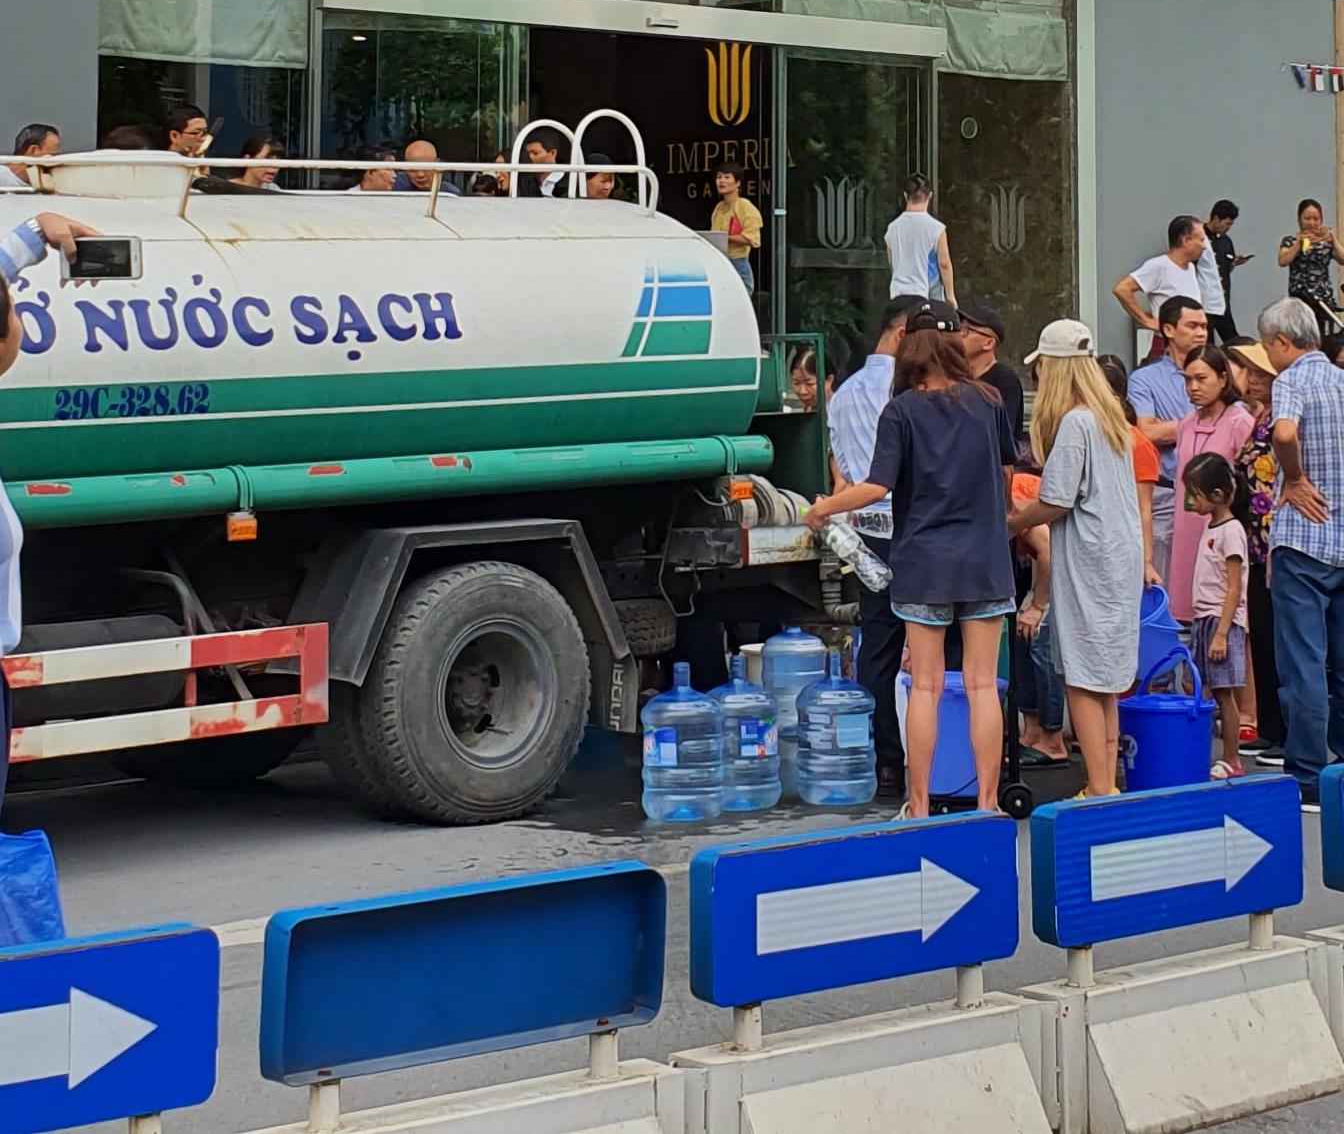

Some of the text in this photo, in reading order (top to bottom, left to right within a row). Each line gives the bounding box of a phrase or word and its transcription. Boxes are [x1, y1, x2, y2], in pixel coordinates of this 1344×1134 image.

[687, 180, 771, 199] GAEN
[75, 274, 274, 353] NƯỚC
[290, 292, 463, 361] SẠCH
[56, 383, 210, 420] 29C-328.62
